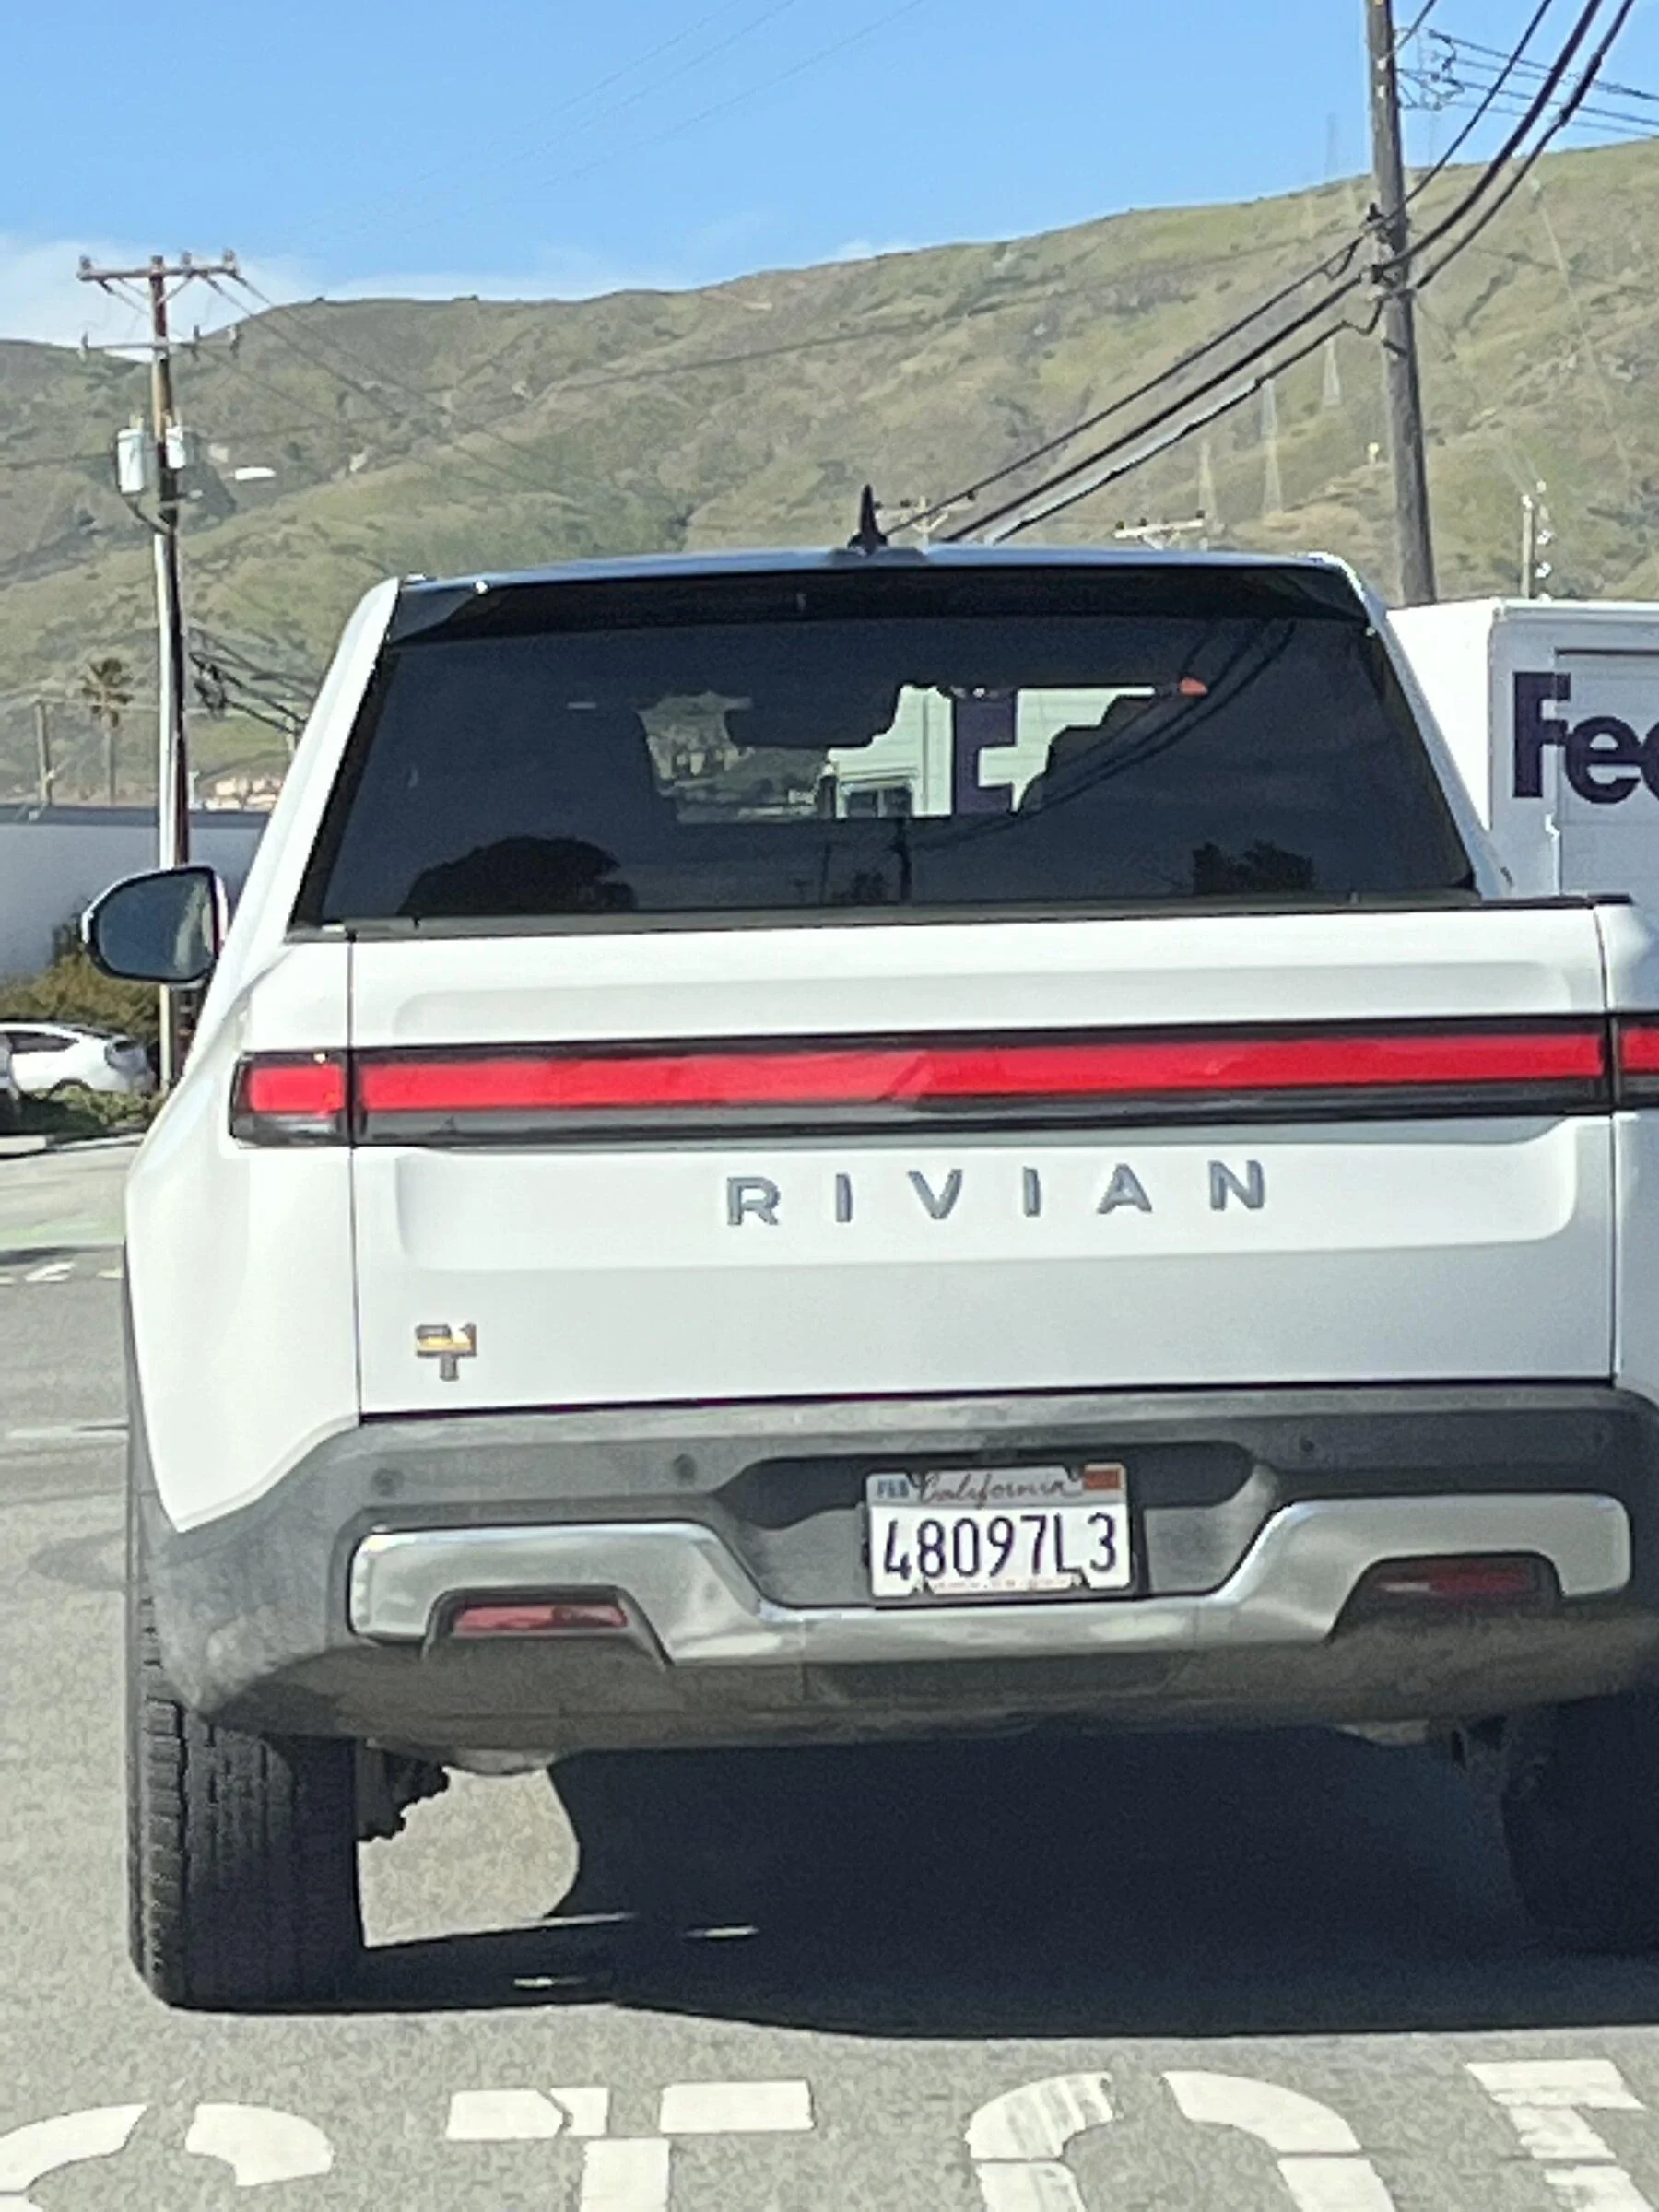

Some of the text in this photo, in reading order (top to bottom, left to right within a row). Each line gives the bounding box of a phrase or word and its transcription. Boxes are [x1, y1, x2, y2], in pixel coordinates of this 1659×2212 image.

[1512, 671, 1659, 805] Fe
[726, 1159, 1265, 1227] RIVIAN
[883, 1512, 1117, 1581] 48097L3
